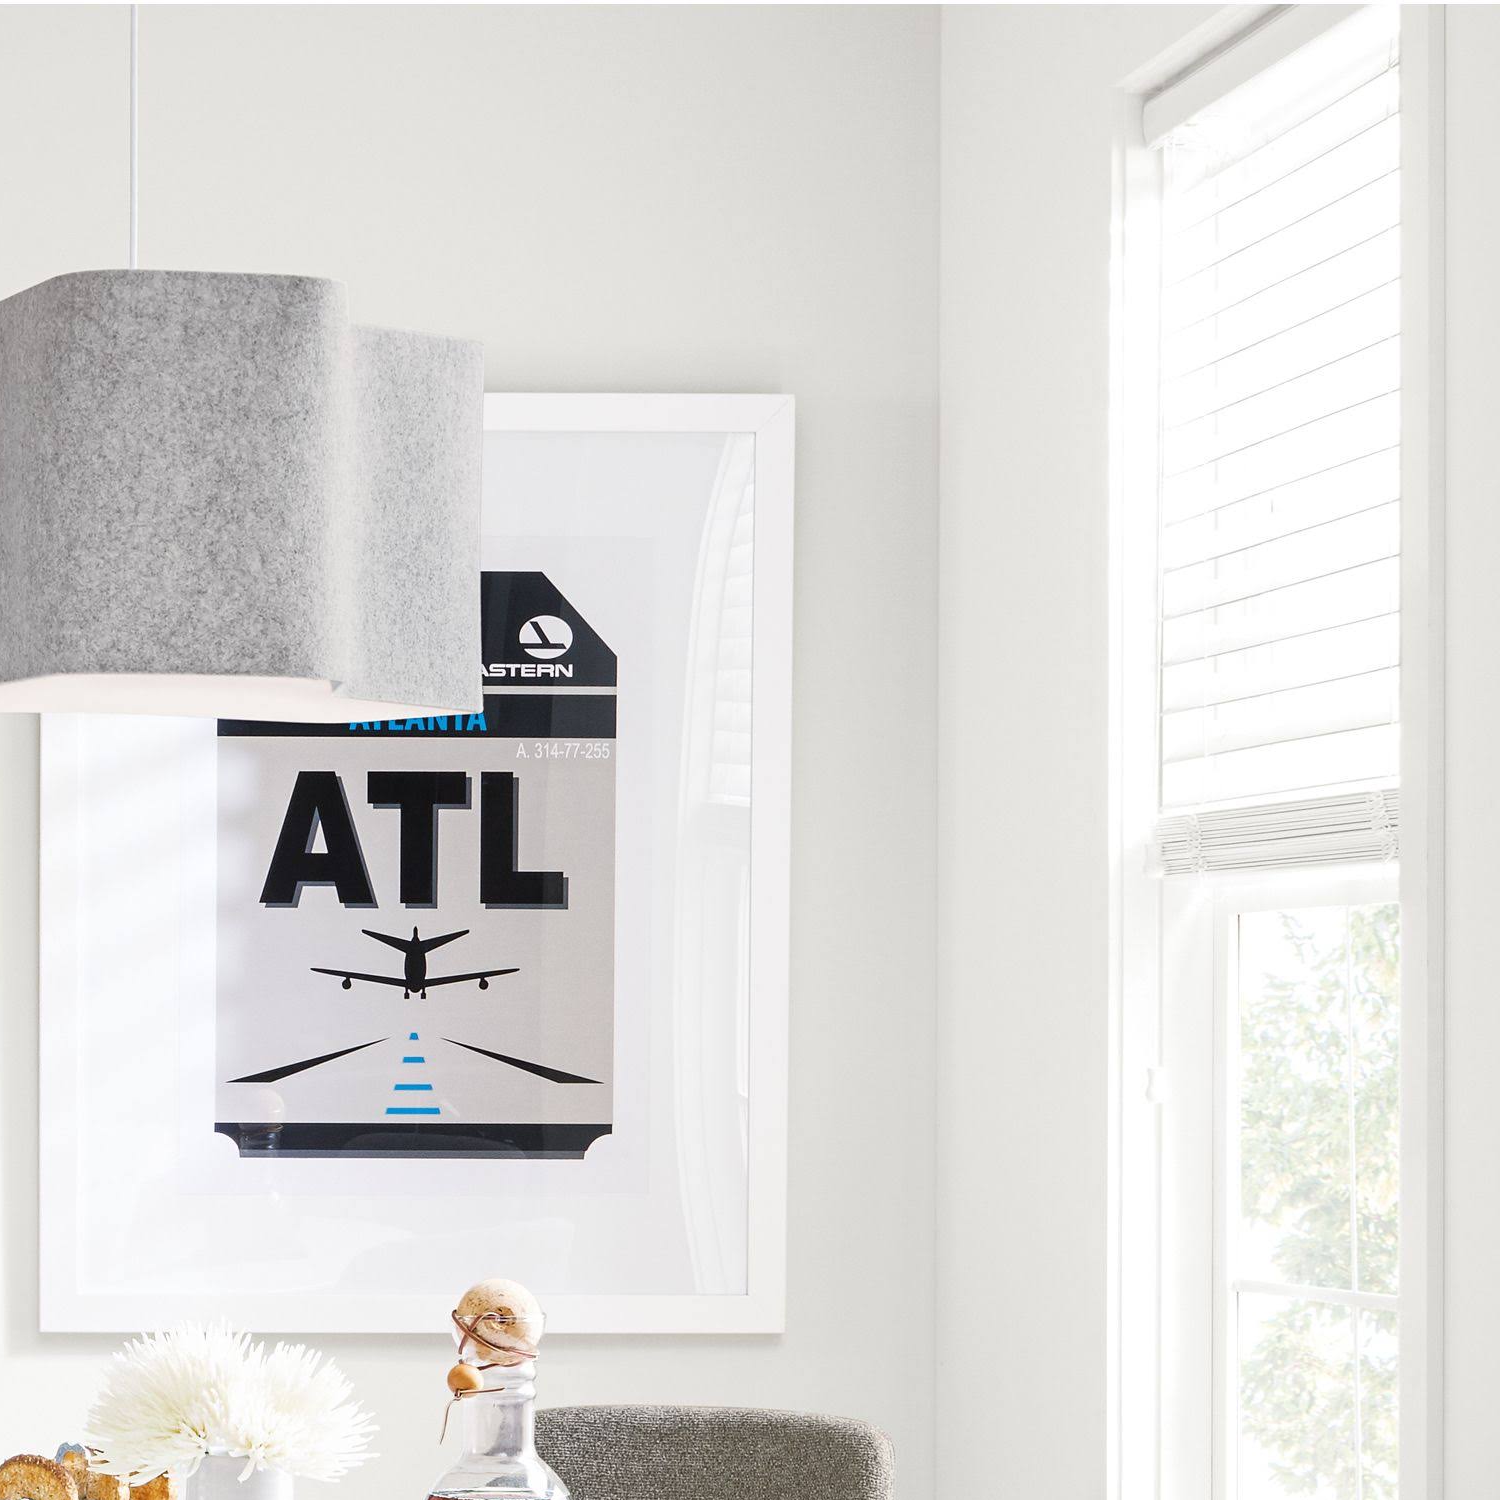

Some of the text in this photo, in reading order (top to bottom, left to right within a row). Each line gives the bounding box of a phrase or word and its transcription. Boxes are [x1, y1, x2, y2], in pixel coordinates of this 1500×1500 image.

[481, 663, 574, 678] ASTERN
[516, 742, 610, 759] A. 314-77-255
[259, 771, 569, 909] ATL
